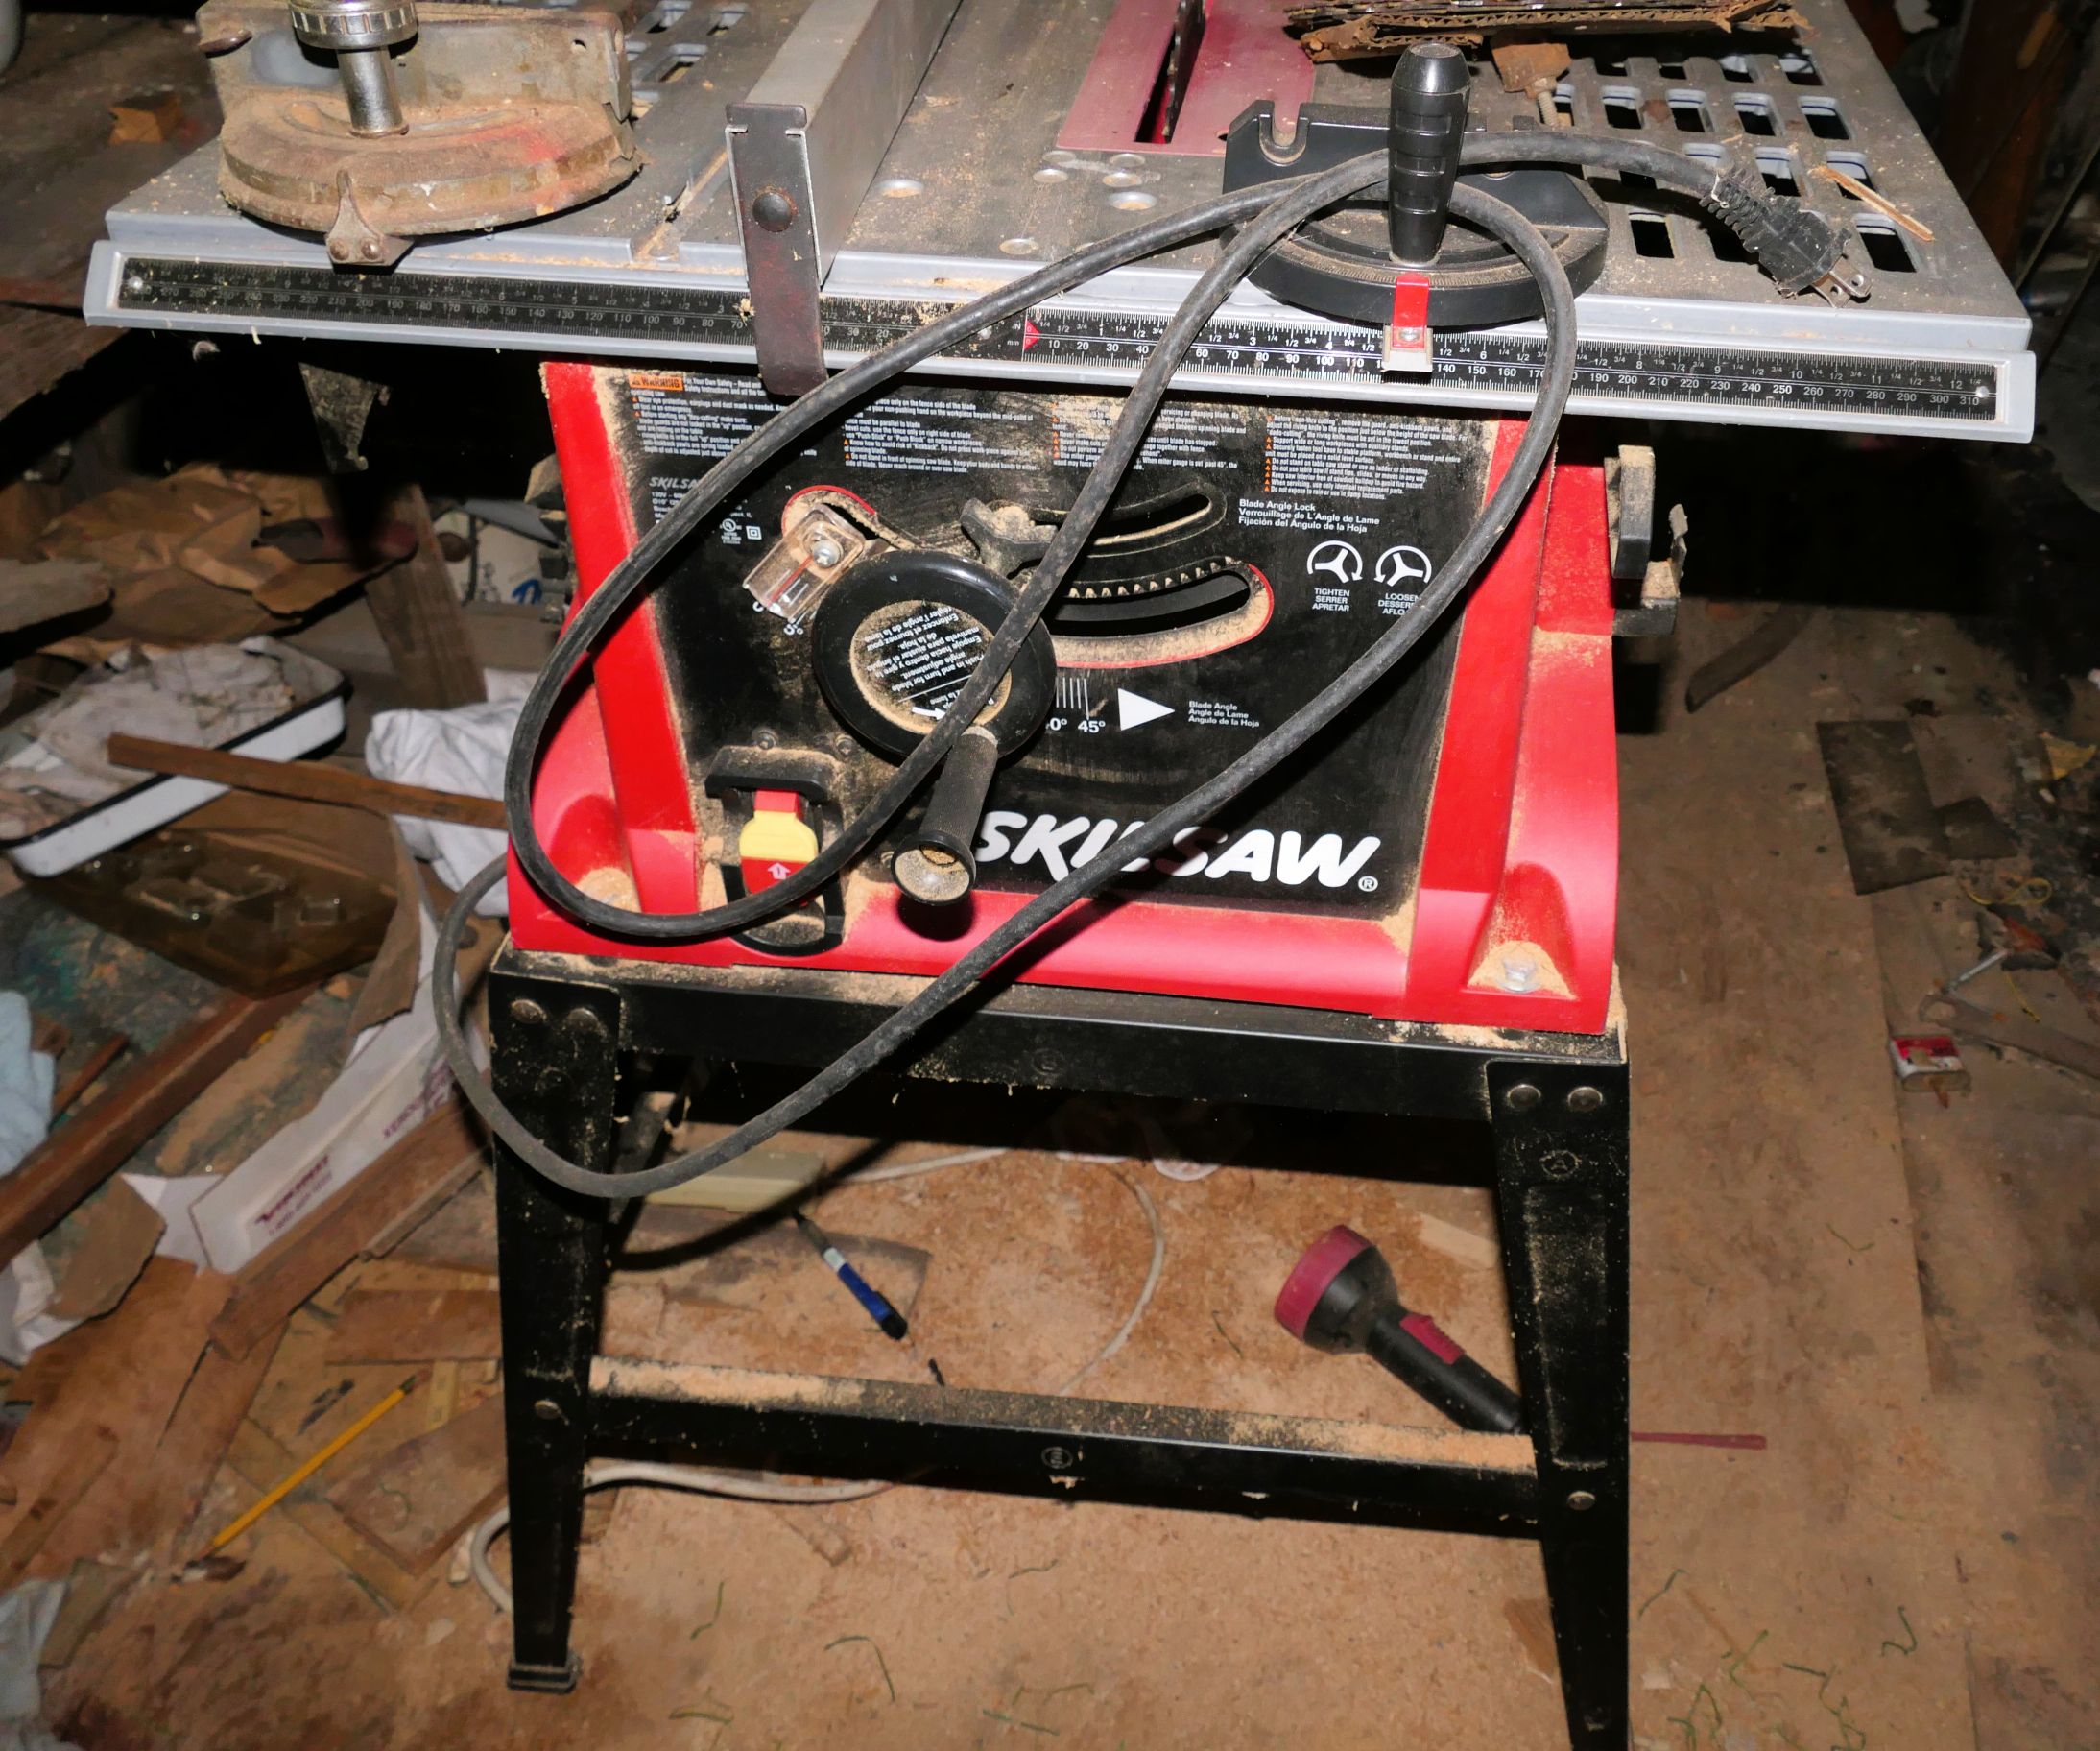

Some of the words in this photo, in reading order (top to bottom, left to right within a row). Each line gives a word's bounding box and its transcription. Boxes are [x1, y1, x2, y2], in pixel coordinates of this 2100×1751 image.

[1057, 324, 1070, 333] 1/2
[1133, 328, 1146, 338] 1/2
[1209, 334, 1222, 343] 1/2
[1250, 336, 1256, 347] 3
[1285, 339, 1299, 348] 1/2
[1325, 341, 1333, 350] 4
[1362, 343, 1375, 352] 1/2
[1439, 348, 1452, 357] 1/2
[1479, 350, 1487, 360] 6
[1516, 352, 1530, 362] 1/2
[1576, 352, 1587, 361] 1/4
[1635, 360, 1643, 370] 8
[1672, 362, 1685, 371] 1/2
[1714, 365, 1721, 374] 9
[1752, 368, 1764, 376] 1/2
[1790, 370, 1803, 380] 10
[1830, 372, 1843, 381] 1/2
[1872, 374, 1882, 384] 11
[1909, 377, 1922, 386] 1/2
[1950, 379, 1963, 390] 12
[1048, 340, 1061, 349] 10
[1076, 341, 1089, 350] 20
[1106, 343, 1119, 352] 30
[1135, 345, 1149, 354] 40
[1195, 348, 1208, 358] 60
[1227, 350, 1239, 360] 70
[1255, 351, 1269, 362] 80
[1285, 353, 1300, 364] 90
[1316, 355, 1335, 366] 100
[1346, 357, 1364, 368] 110
[1437, 363, 1456, 373] 140
[1468, 365, 1486, 375] 150
[1498, 368, 1516, 377] 160
[1590, 372, 1609, 383] 190
[1618, 374, 1637, 385] 200
[1649, 376, 1668, 387] 210
[1680, 378, 1700, 389] 220
[1711, 380, 1730, 391] 230
[1741, 382, 1761, 393] 240
[1773, 384, 1793, 395] 250
[1803, 386, 1824, 396] 260
[1834, 388, 1854, 398] 270
[1866, 390, 1886, 400] 280
[1897, 392, 1917, 402] 290
[1929, 394, 1949, 404] 300
[1960, 396, 1979, 406] 310
[641, 376, 680, 388] WARNING
[1239, 498, 1264, 508] Blade
[1266, 501, 1292, 512] Angle
[1294, 502, 1316, 512] Lock
[1239, 508, 1292, 520] Verrouillage
[1294, 511, 1305, 520] de
[1343, 515, 1354, 524] de
[1356, 516, 1380, 525] Lame
[1275, 518, 1288, 527] del
[1324, 521, 1335, 531] de
[1337, 522, 1345, 531] la
[1347, 523, 1368, 534] Hoja
[1314, 588, 1350, 597] TIGHTEN
[1315, 595, 1348, 605] SERRER
[1378, 600, 1415, 610] DESSER
[1312, 602, 1349, 612] APRETAR
[1382, 608, 1408, 616] AFLO
[922, 613, 959, 630] Enfoncez
[882, 629, 893, 637] la
[892, 624, 902, 634] de
[913, 626, 922, 636] et
[944, 626, 980, 642] manivela
[864, 632, 884, 643] lame
[884, 630, 914, 645] tournez
[917, 636, 926, 644] la
[926, 632, 937, 640] de
[867, 638, 885, 652] pour
[927, 637, 945, 650] para
[951, 635, 982, 650] Empuje
[900, 644, 927, 659] ajustar
[930, 645, 952, 658] hacia
[945, 651, 966, 663] angle
[892, 655, 900, 663] el
[898, 660, 906, 669] y
[905, 654, 930, 666] dentro
[956, 660, 965, 669] in
[883, 664, 898, 674] gire
[943, 664, 956, 676] and
[913, 675, 925, 684] for
[924, 670, 942, 681] turn
[891, 681, 914, 692] blade
[1188, 700, 1213, 709] Blade
[1214, 702, 1238, 712] Angle
[1188, 708, 1212, 718] Angle
[1214, 709, 1225, 718] de
[1226, 710, 1249, 719] Lame
[1218, 718, 1229, 727] de
[1230, 718, 1239, 727] la
[1240, 719, 1260, 729] Hoja
